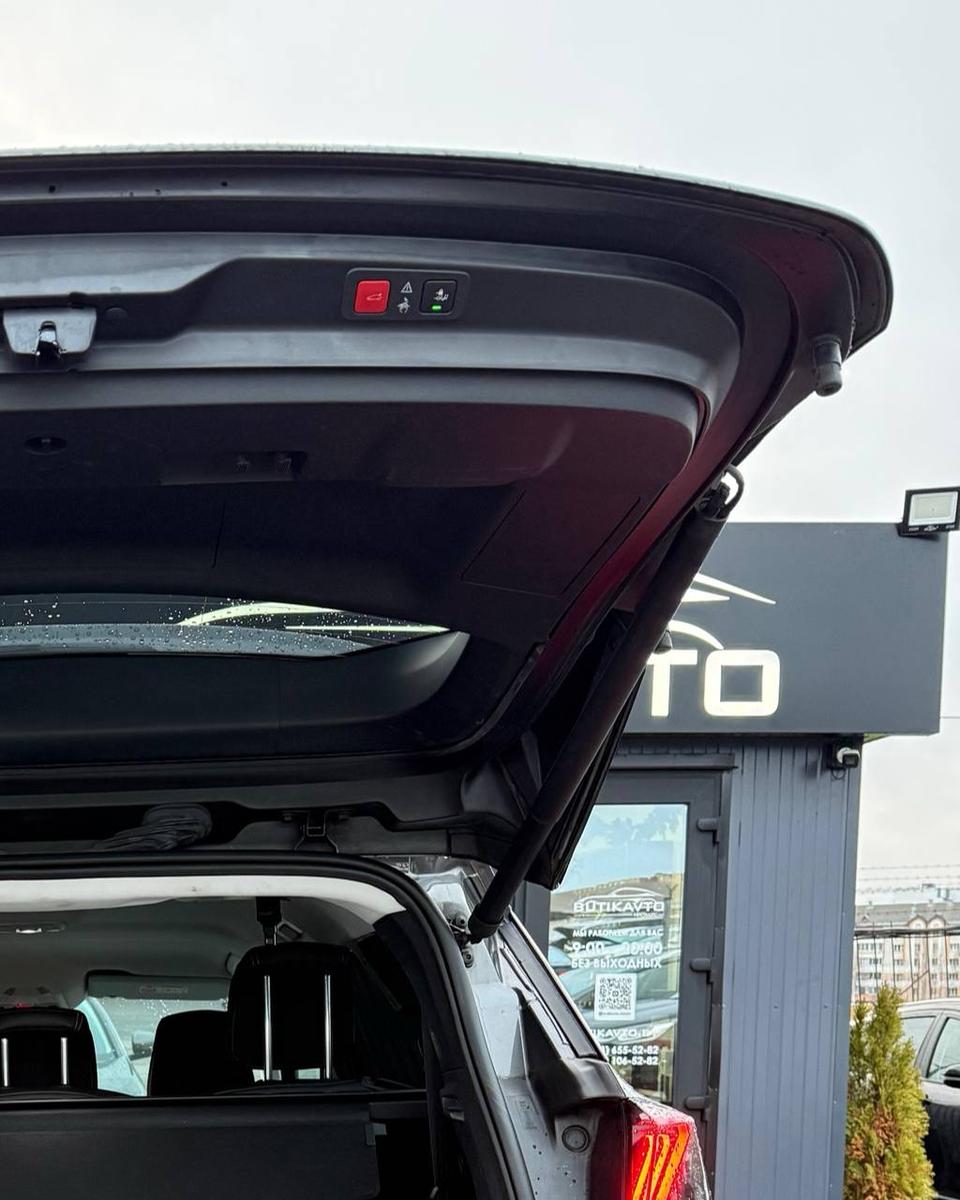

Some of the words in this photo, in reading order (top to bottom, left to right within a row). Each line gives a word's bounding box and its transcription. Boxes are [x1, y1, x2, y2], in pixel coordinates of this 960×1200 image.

[645, 648, 781, 717] TO
[573, 901, 665, 913] BUTIKAVTO
[593, 958, 662, 969] ВЫХОДНЫХ
